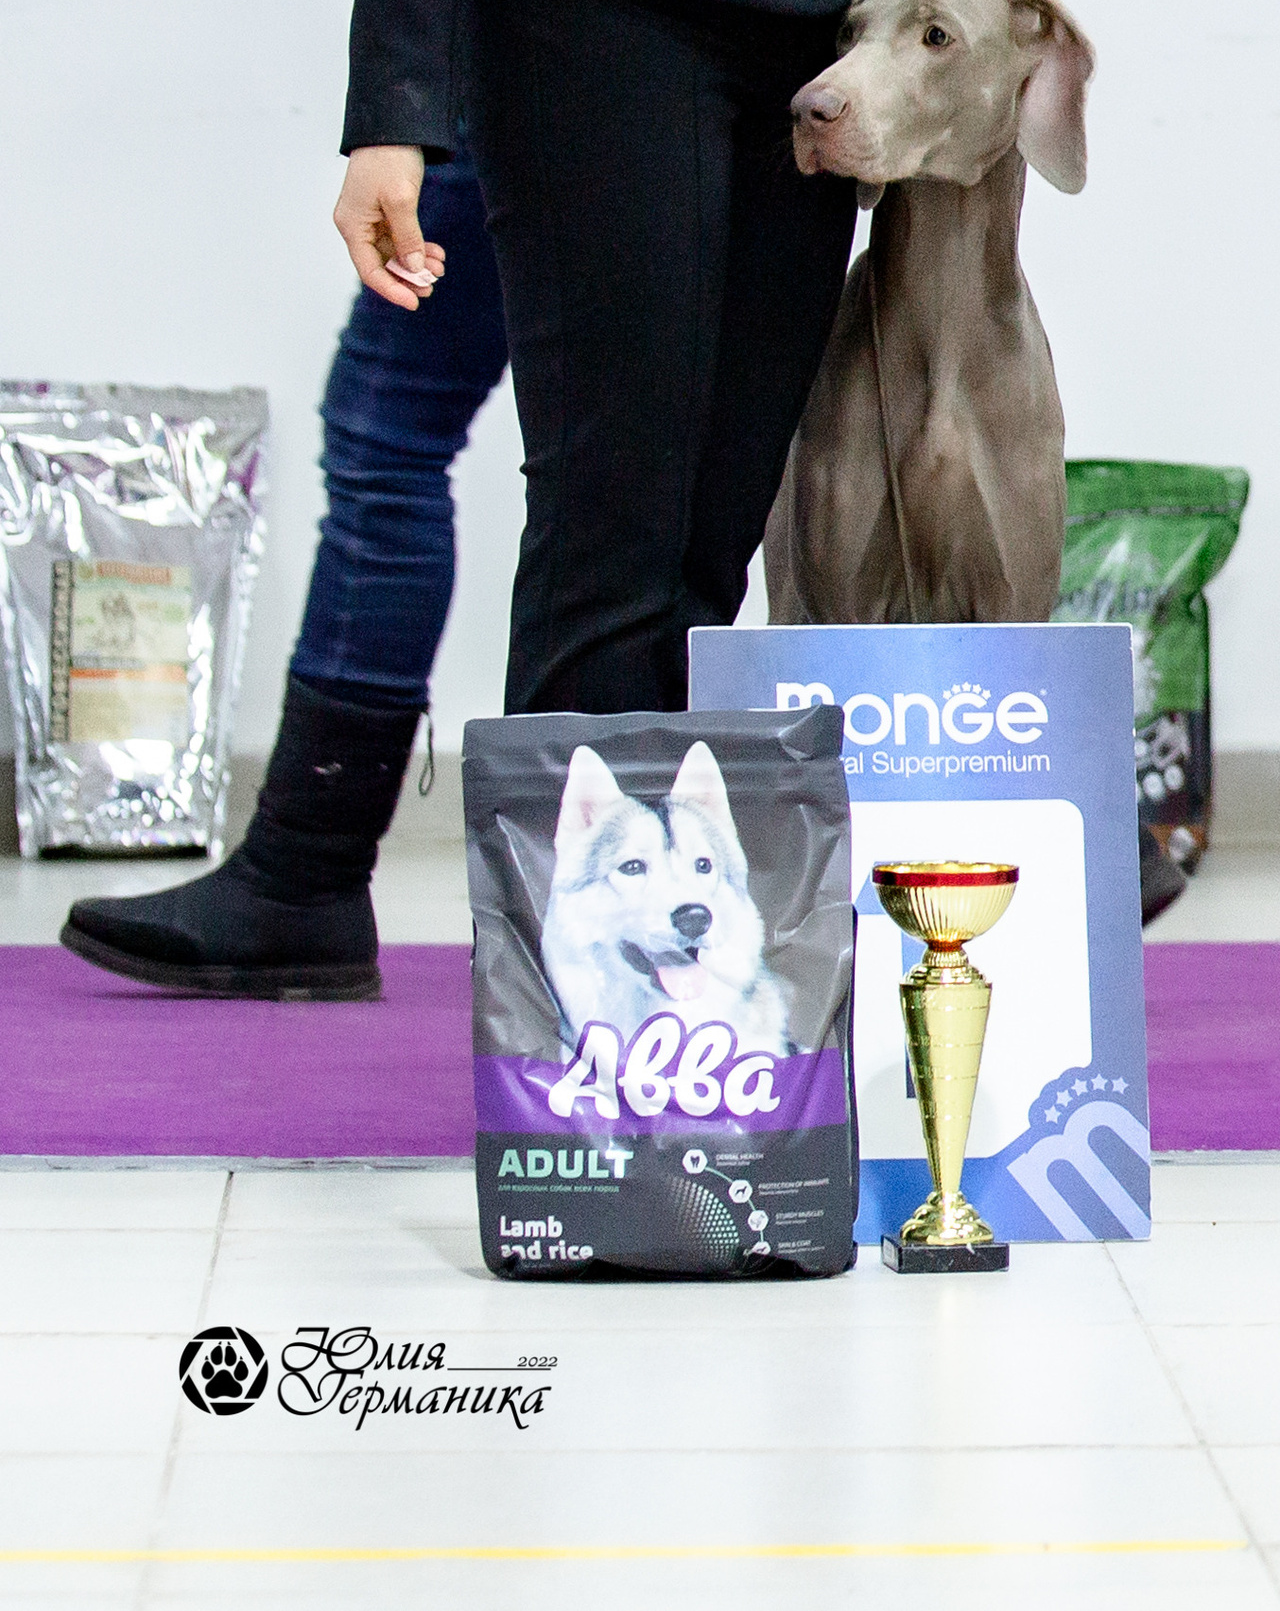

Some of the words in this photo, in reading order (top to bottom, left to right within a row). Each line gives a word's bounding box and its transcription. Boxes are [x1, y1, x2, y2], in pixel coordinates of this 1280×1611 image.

[871, 749, 1050, 778] Superpremium
[498, 1148, 634, 1179] ADULT
[500, 1215, 563, 1238] Lamb
[548, 1239, 594, 1260] rice
